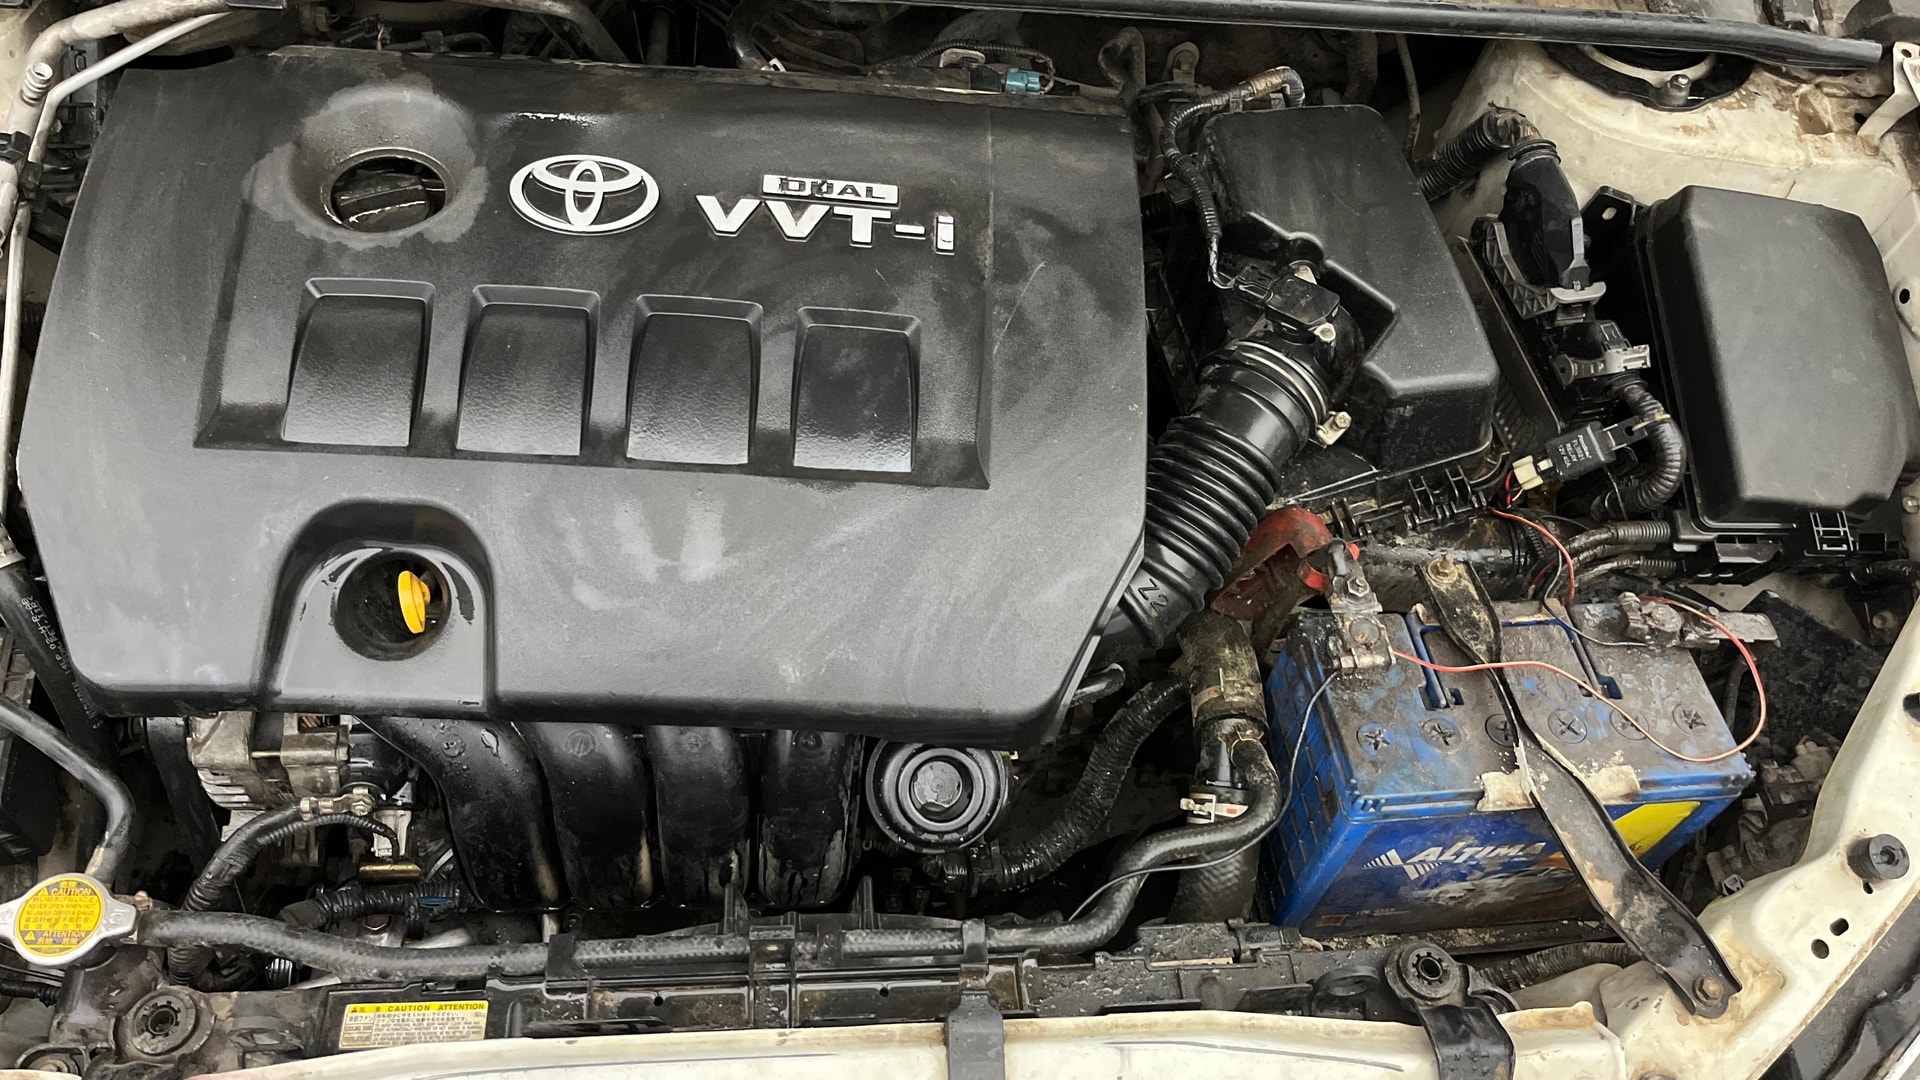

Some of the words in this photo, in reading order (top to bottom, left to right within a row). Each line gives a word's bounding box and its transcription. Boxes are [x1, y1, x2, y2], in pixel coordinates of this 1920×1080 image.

[779, 177, 887, 200] DUAL
[1565, 442, 1578, 462] RELAY
[1406, 841, 1546, 864] ALTIMA
[51, 888, 91, 896] CAUTION
[438, 1003, 485, 1011] ATTENTION
